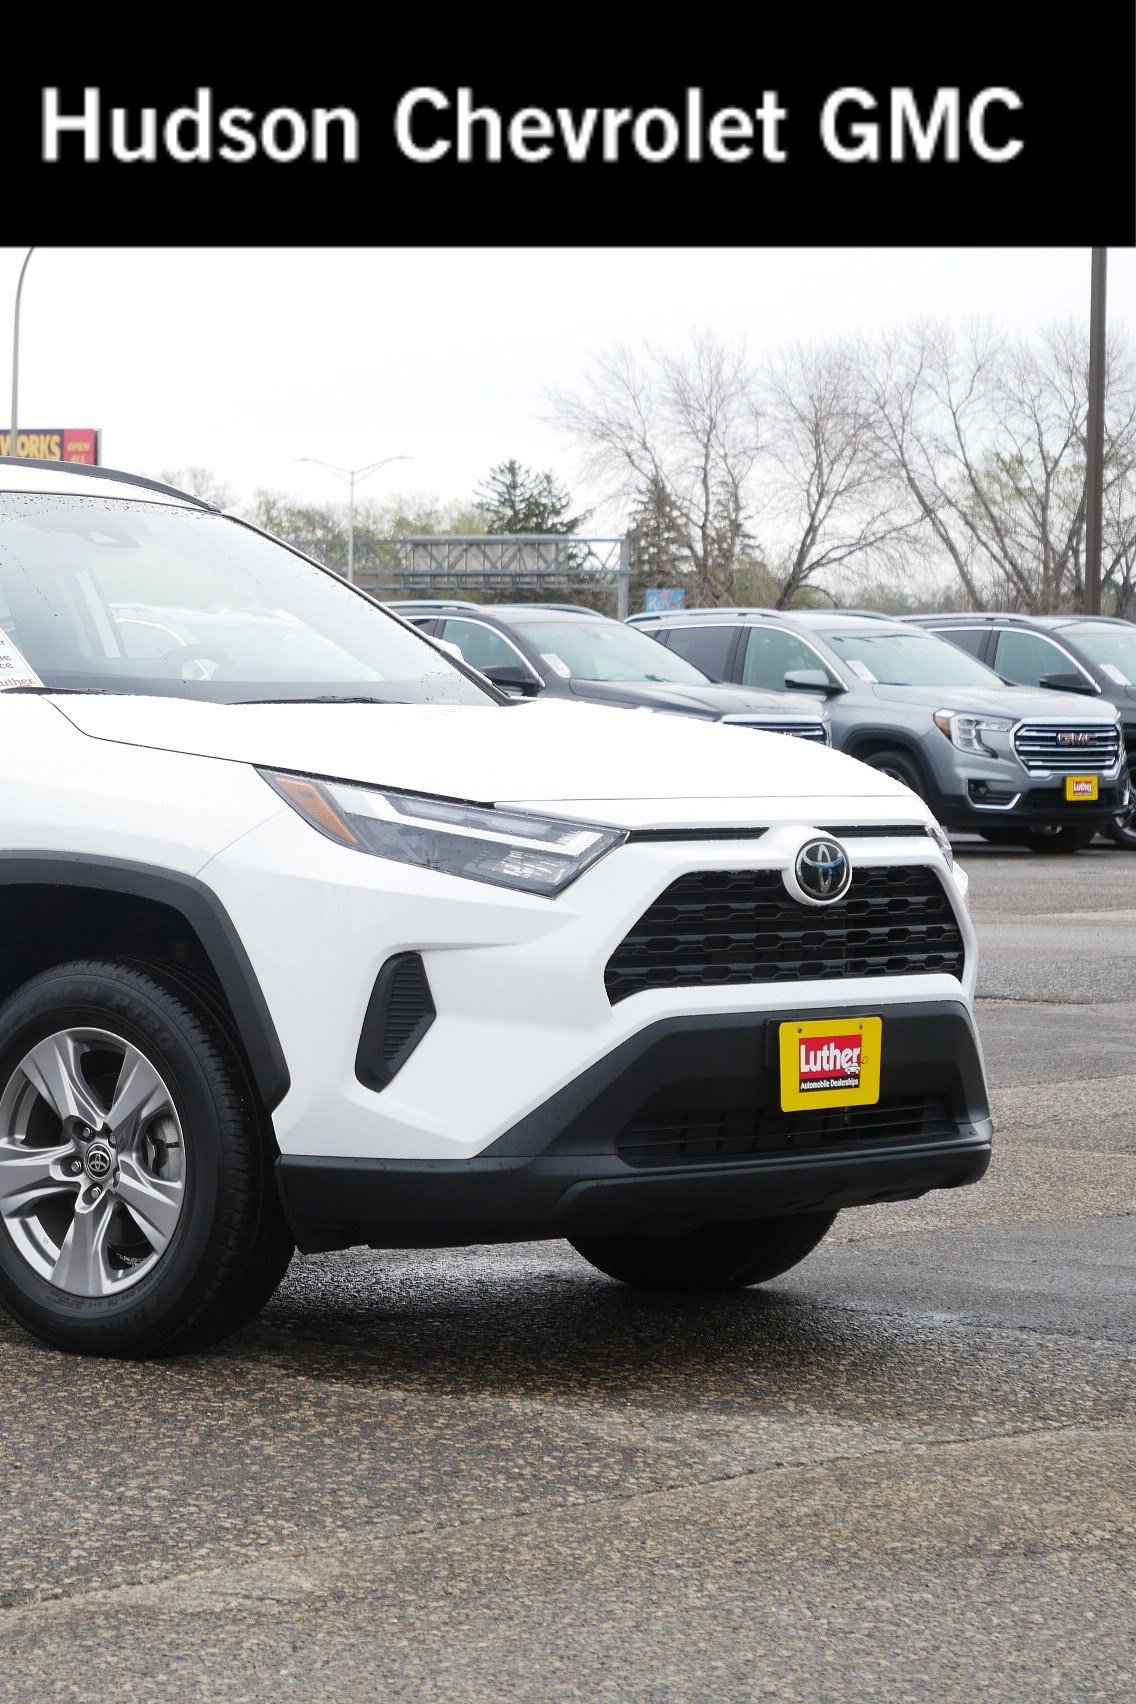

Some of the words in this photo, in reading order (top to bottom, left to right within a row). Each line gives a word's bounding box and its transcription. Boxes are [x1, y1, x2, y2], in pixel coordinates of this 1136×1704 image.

[67, 441, 91, 452] OPEN
[1056, 732, 1097, 745] GMC
[1073, 781, 1092, 792] Luther
[800, 1042, 861, 1073] Luther
[800, 1080, 830, 1090] Automobile
[830, 1077, 859, 1088] Dealerships
